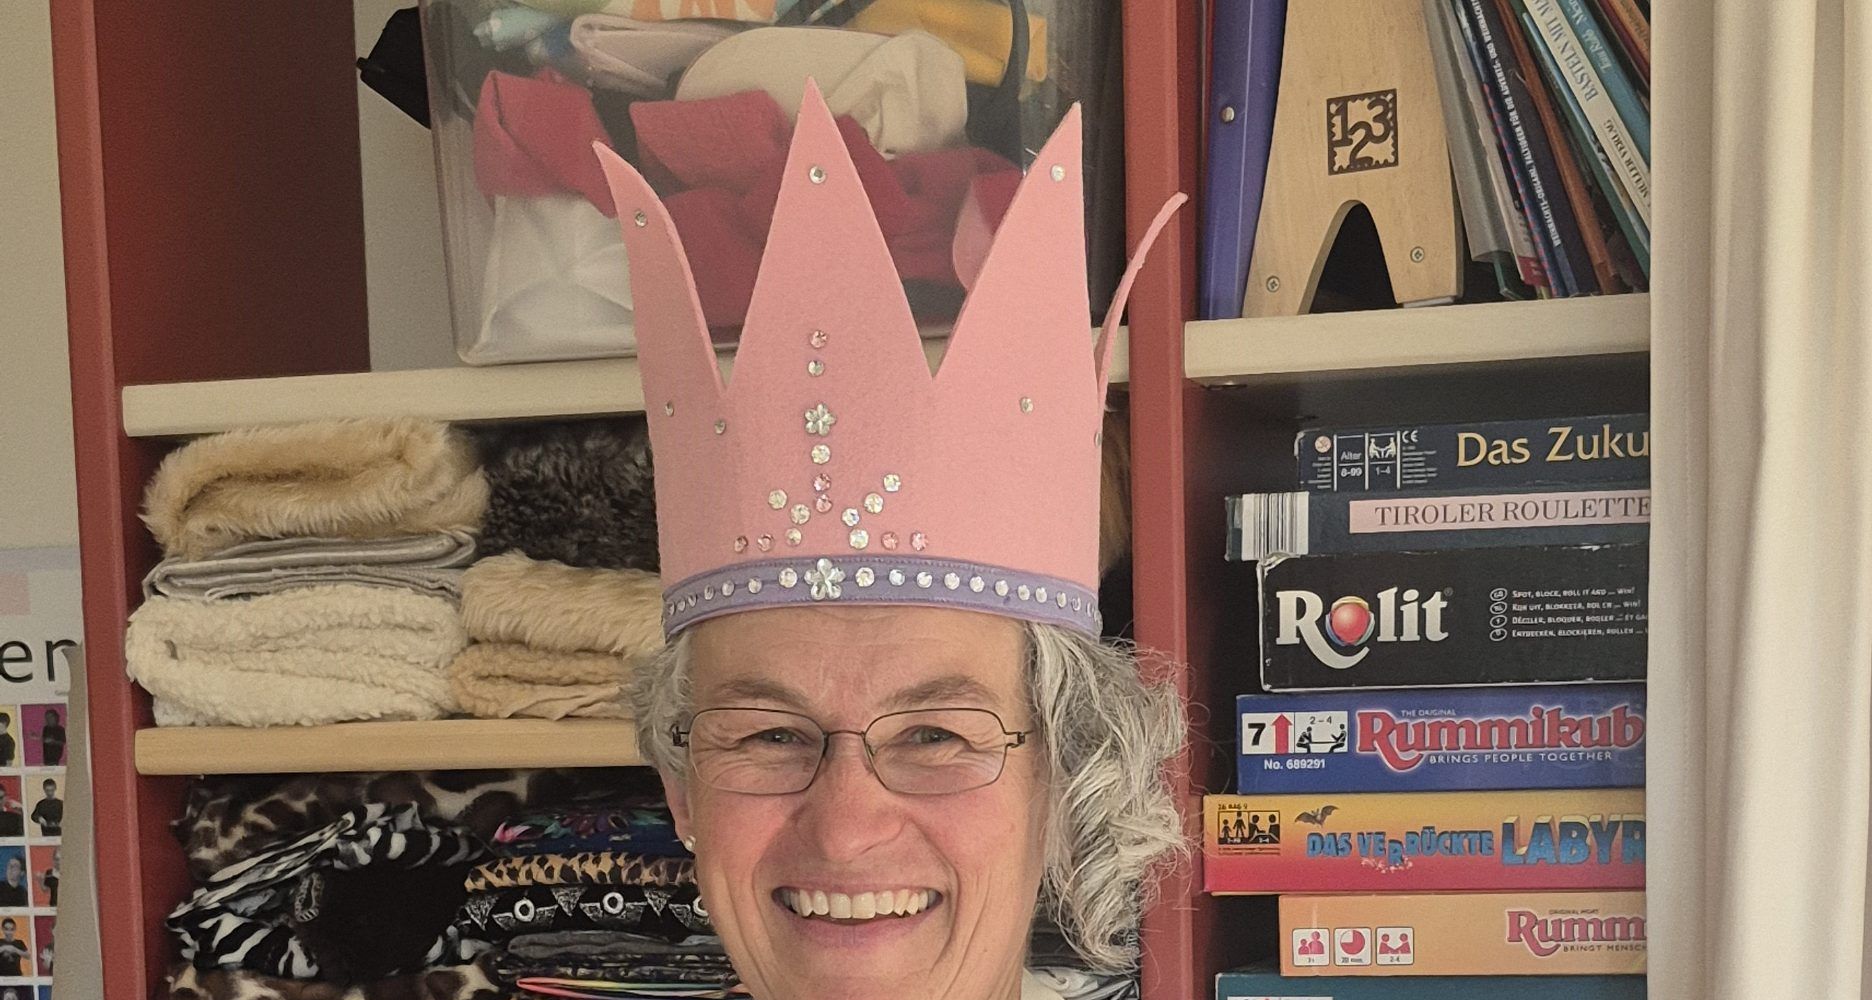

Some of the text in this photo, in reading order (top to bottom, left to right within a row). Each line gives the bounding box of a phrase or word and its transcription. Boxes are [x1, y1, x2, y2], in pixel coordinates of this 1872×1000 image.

[1544, 16, 1567, 42] MIT
[1556, 40, 1600, 101] BASTELN
[1601, 118, 1630, 159] VERLAG
[1340, 451, 1362, 461] Alter
[1456, 432, 1531, 468] Das
[1546, 423, 1649, 461] Zuku
[1374, 495, 1650, 526] TIROLER ROULETTE
[1275, 586, 1450, 670] Rolit
[1401, 708, 1456, 717] THE ORIGINAL
[1247, 722, 1266, 746] 7
[1356, 704, 1645, 771] Rummikub
[1263, 757, 1326, 770] No. 689291
[1429, 751, 1613, 764] BRINGS PEOPLE TOGETHER
[1307, 814, 1647, 867] DAS VERRÜCKTE LABYR
[1506, 910, 1647, 957] Rumm
[1563, 945, 1602, 953] BRINGT
